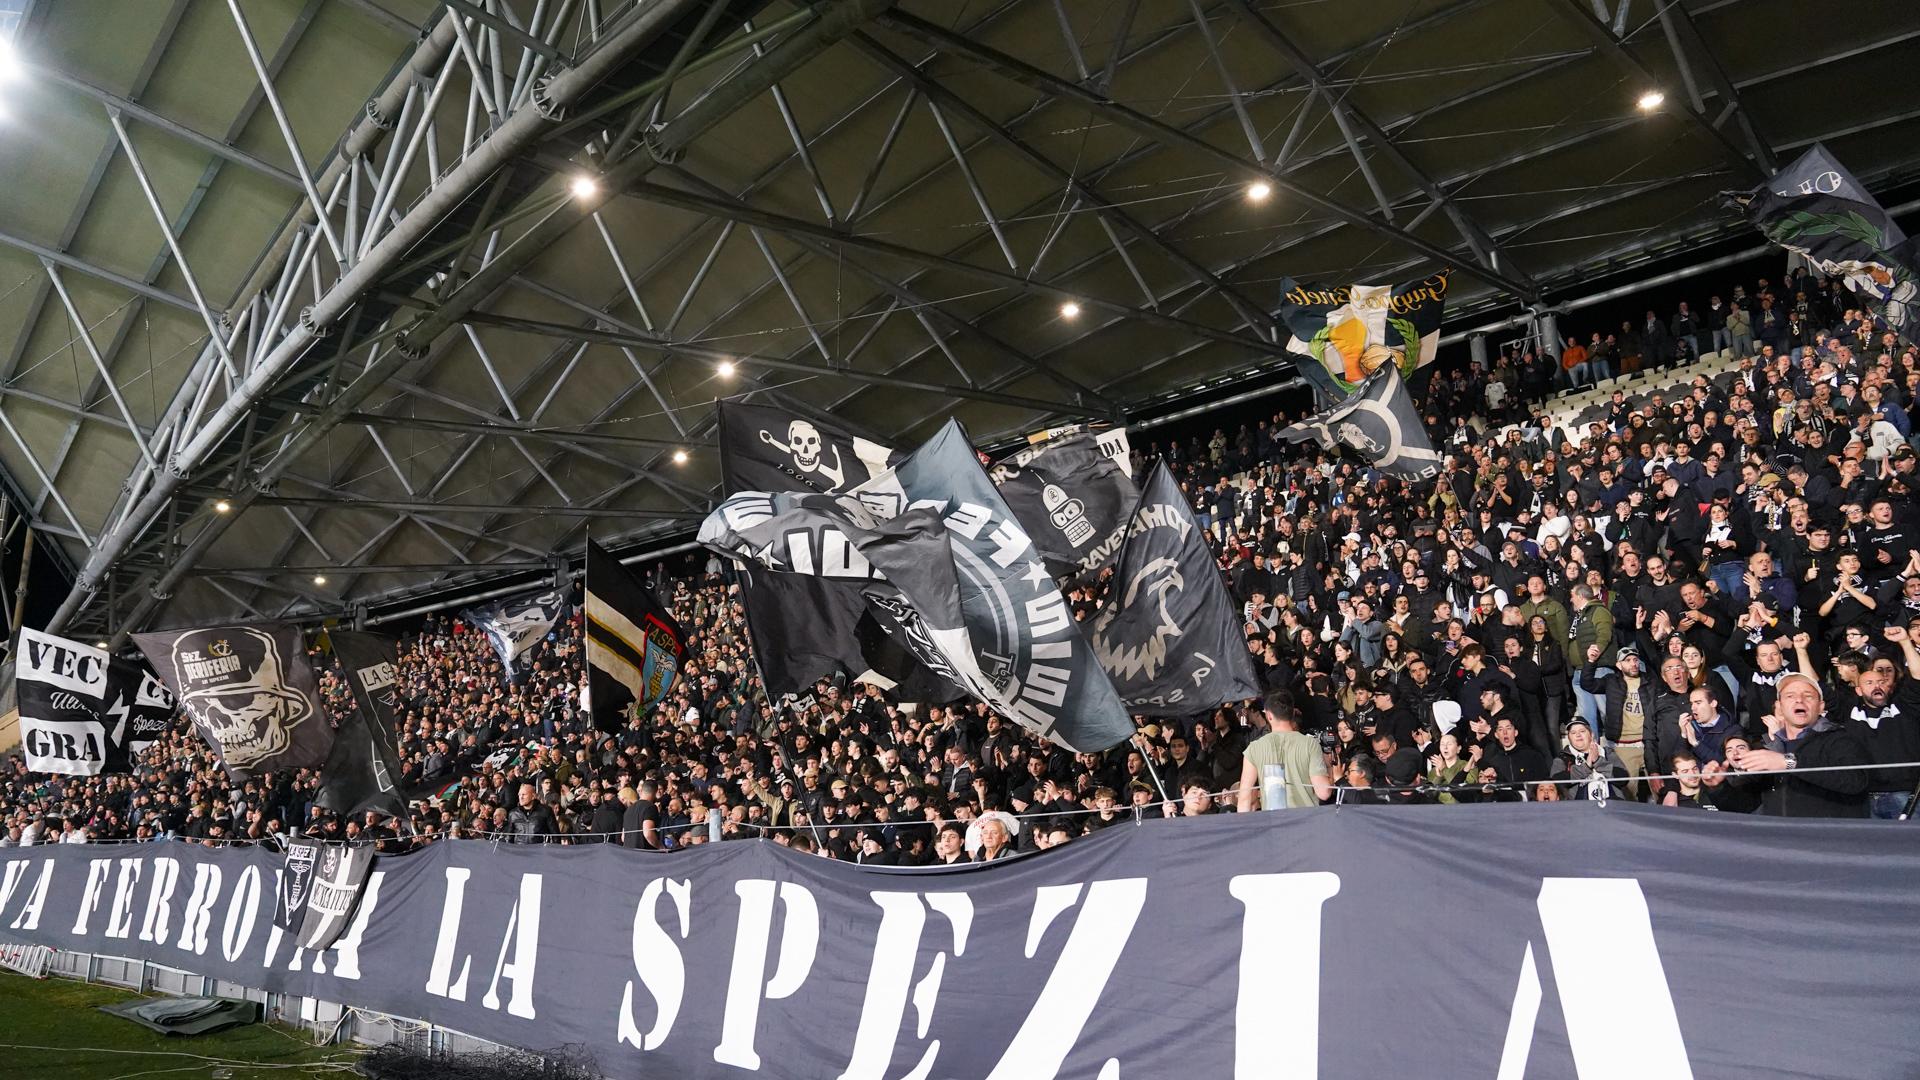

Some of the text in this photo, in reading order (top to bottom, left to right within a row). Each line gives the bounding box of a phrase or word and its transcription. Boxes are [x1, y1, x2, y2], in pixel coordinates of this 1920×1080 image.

[25, 728, 102, 762] GRA
[425, 866, 544, 1020] LA
[617, 871, 1695, 1080] SPEZIA
